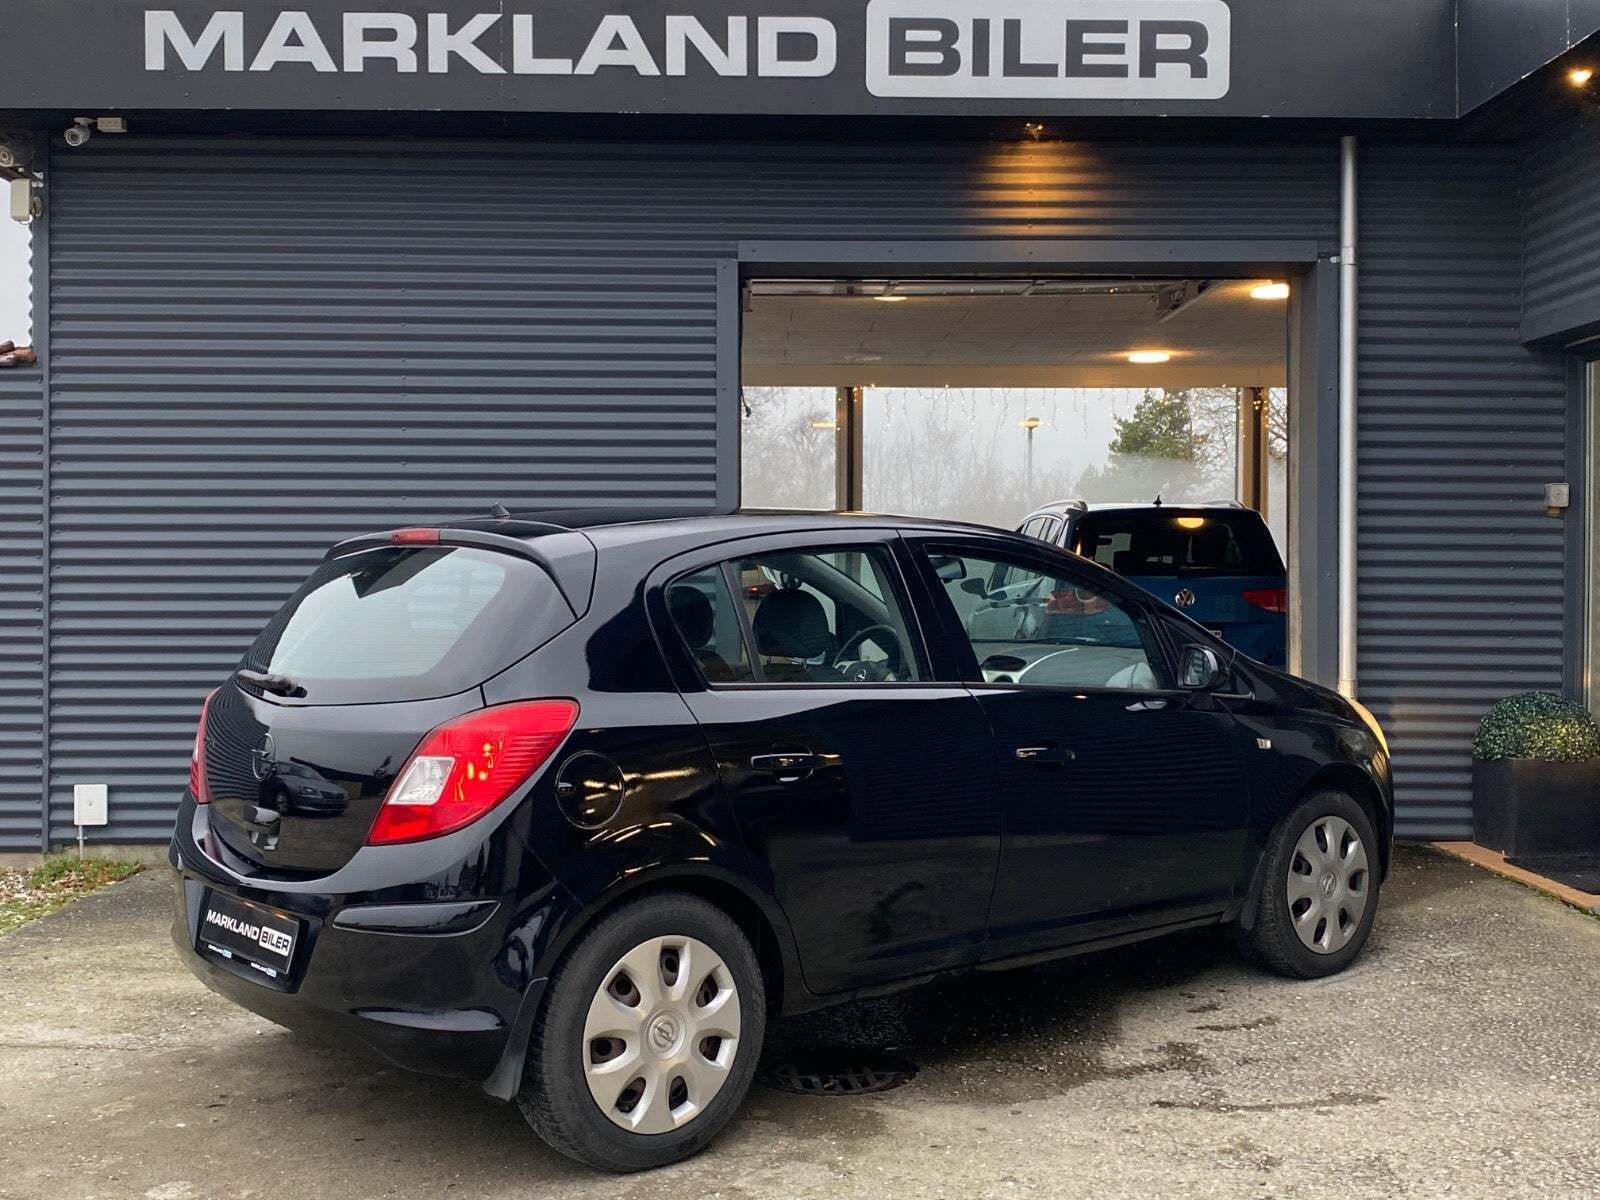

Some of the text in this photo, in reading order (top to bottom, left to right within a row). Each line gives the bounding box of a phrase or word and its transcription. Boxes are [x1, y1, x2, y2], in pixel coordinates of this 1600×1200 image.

[144, 10, 1209, 79] MARKLAND BILER
[206, 909, 260, 940] MARKLAND
[261, 930, 290, 953] BILER
